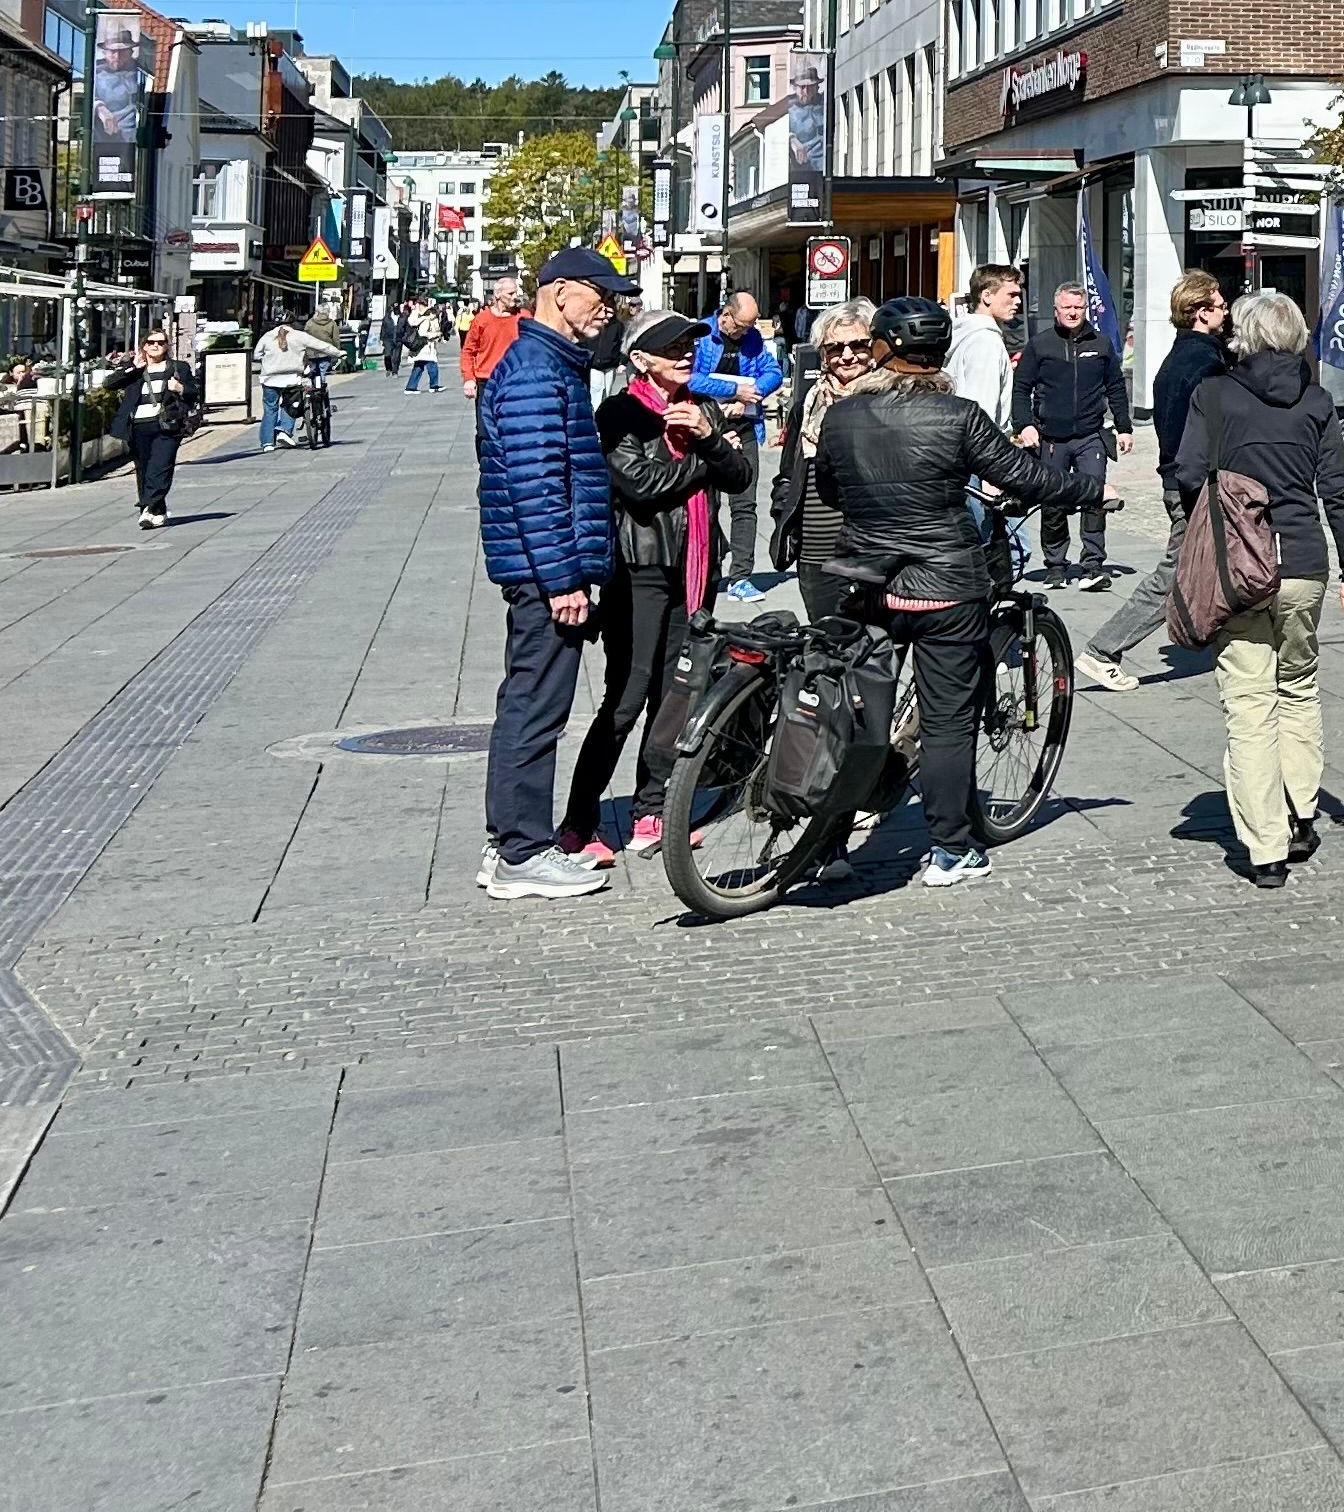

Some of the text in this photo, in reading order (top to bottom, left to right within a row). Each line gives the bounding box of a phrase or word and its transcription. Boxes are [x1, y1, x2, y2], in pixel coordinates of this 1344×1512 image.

[711, 124, 721, 179] KUNSTSILO
[1256, 217, 1281, 229] NOR
[123, 259, 150, 268] Cubus
